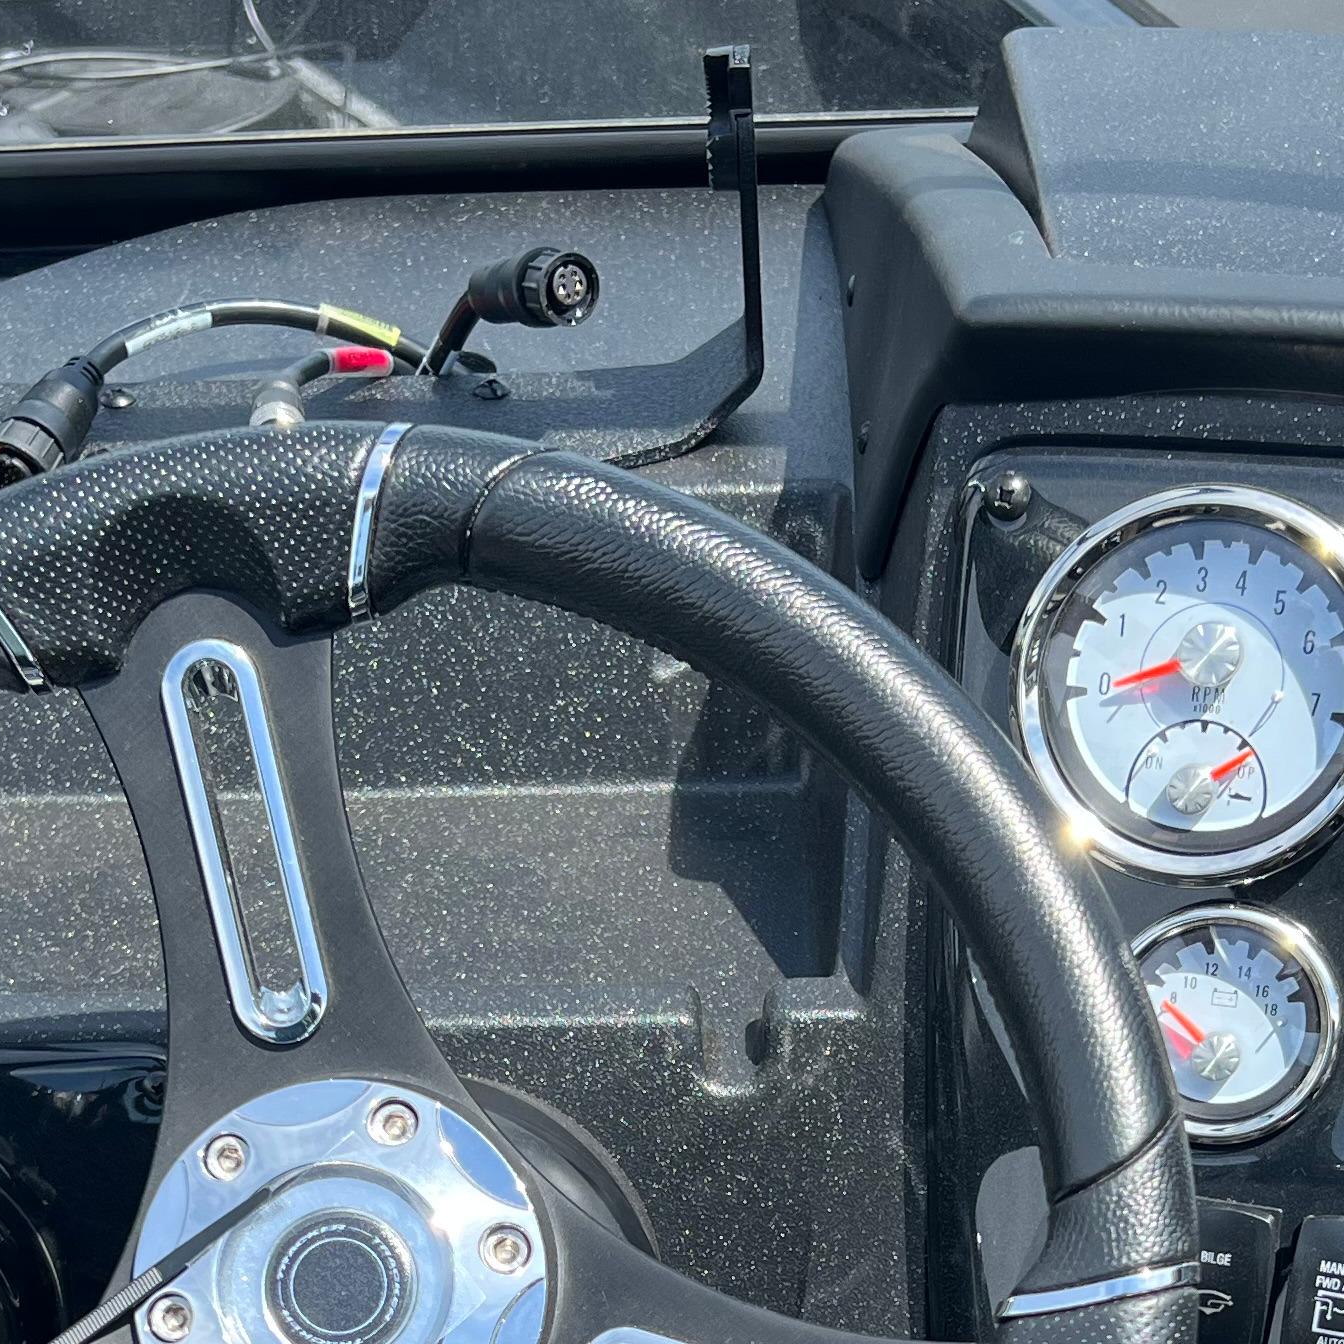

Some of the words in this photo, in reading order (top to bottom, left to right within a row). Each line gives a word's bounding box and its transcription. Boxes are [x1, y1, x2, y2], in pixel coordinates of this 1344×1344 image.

[1196, 566, 1208, 592] 3
[1235, 570, 1247, 596] 4
[1155, 579, 1167, 605] 2
[1274, 590, 1287, 615] 5
[1119, 614, 1126, 637] 1
[1303, 630, 1315, 655] 6
[1098, 672, 1111, 695] 0
[1192, 685, 1225, 703] RPM
[1311, 693, 1321, 716] 7
[1205, 963, 1218, 976] 12
[1238, 966, 1251, 980] 14
[1184, 976, 1197, 989] 10
[1256, 985, 1269, 997] 16
[1170, 992, 1177, 1004] 8
[1264, 1003, 1278, 1016] 18
[276, 1223, 347, 1281] TRACKER
[1201, 1250, 1233, 1267] BILGE
[1315, 1275, 1340, 1290] FWD
